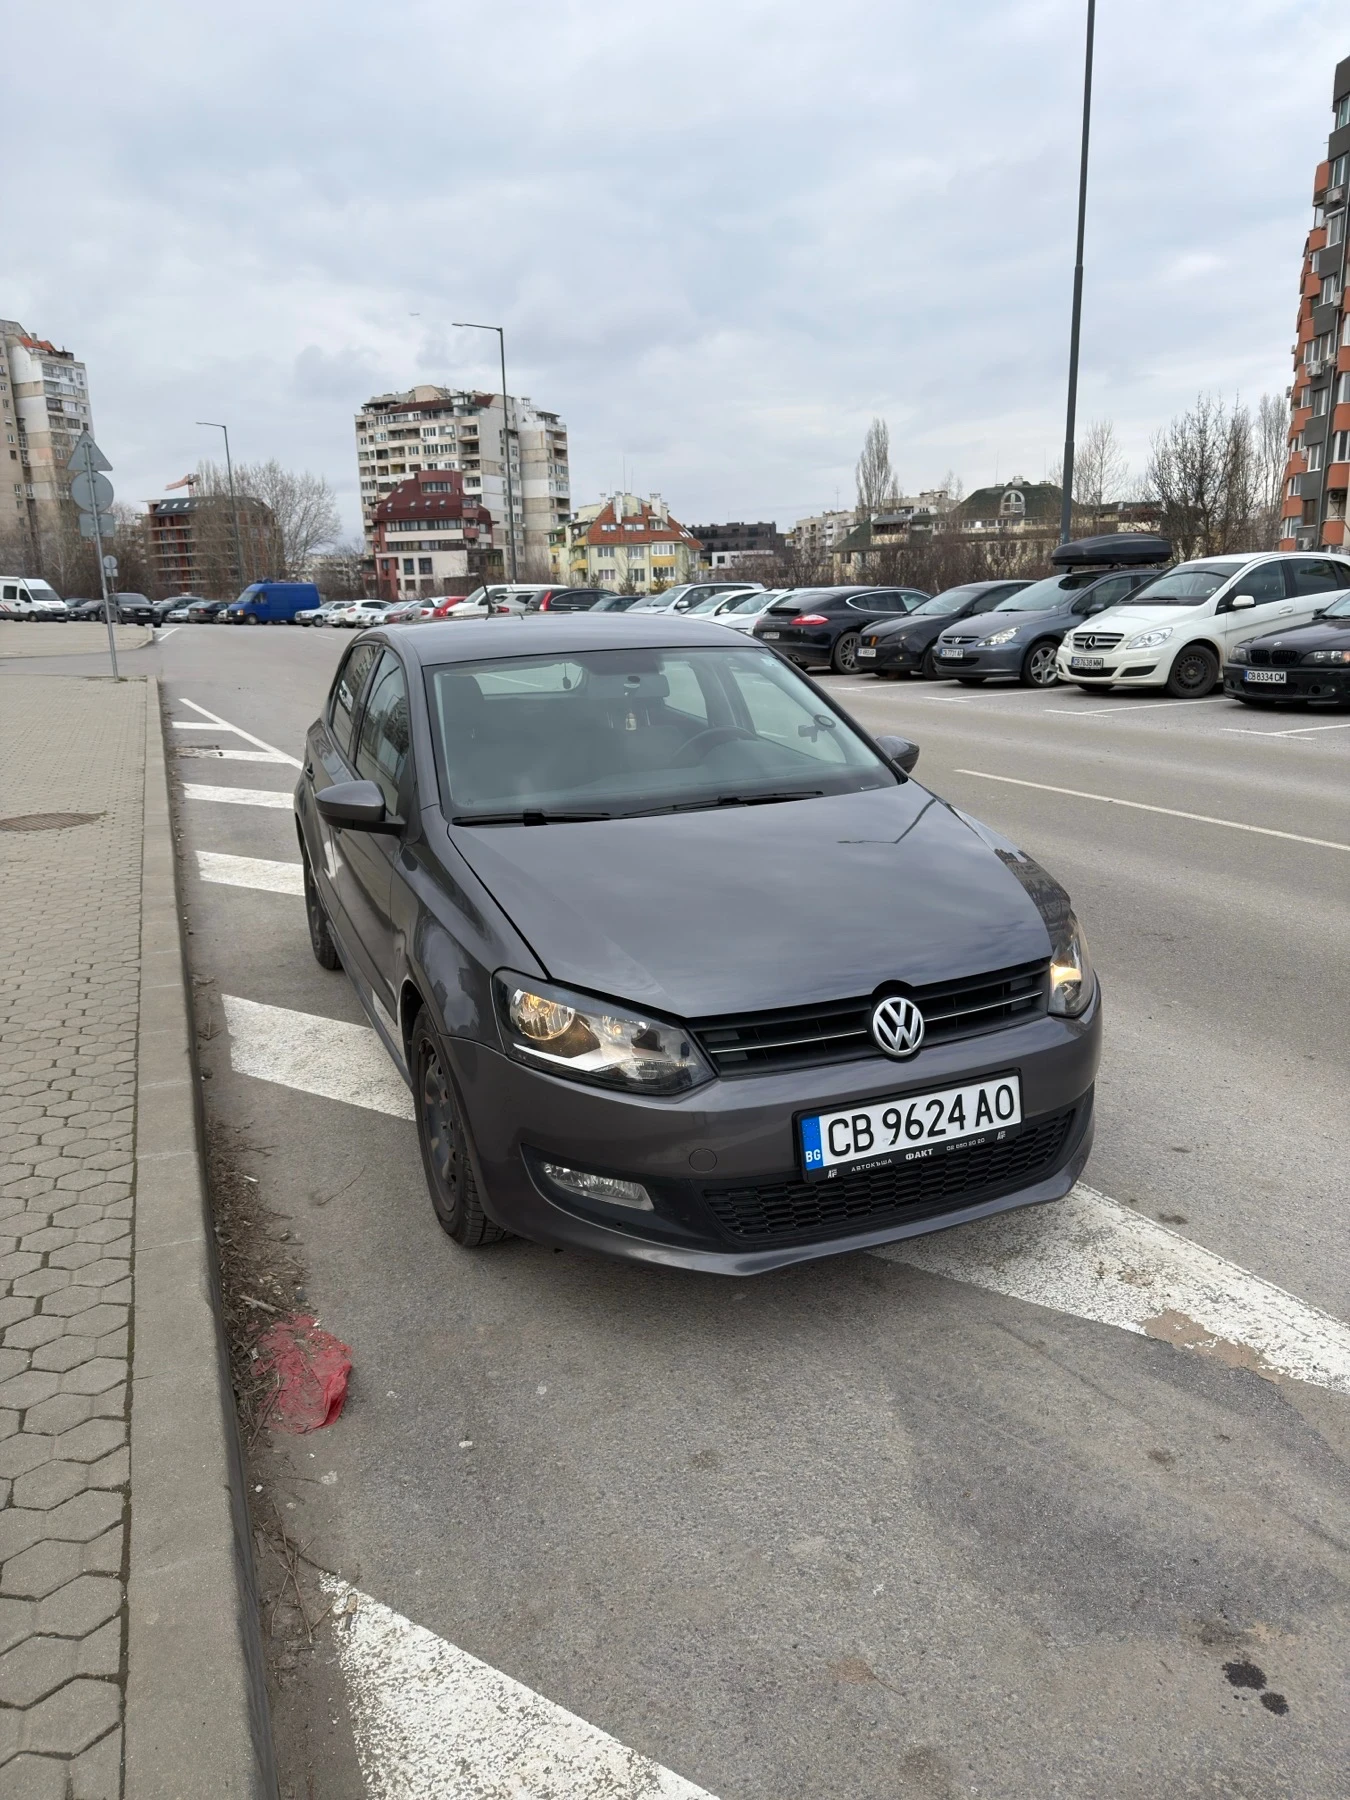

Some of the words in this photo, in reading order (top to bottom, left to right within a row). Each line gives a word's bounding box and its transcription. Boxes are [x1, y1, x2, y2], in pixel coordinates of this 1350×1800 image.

[828, 1114, 875, 1157] CB
[882, 1093, 966, 1147] 9624
[805, 1148, 822, 1163] BG
[905, 1148, 934, 1161] ФАКТ
